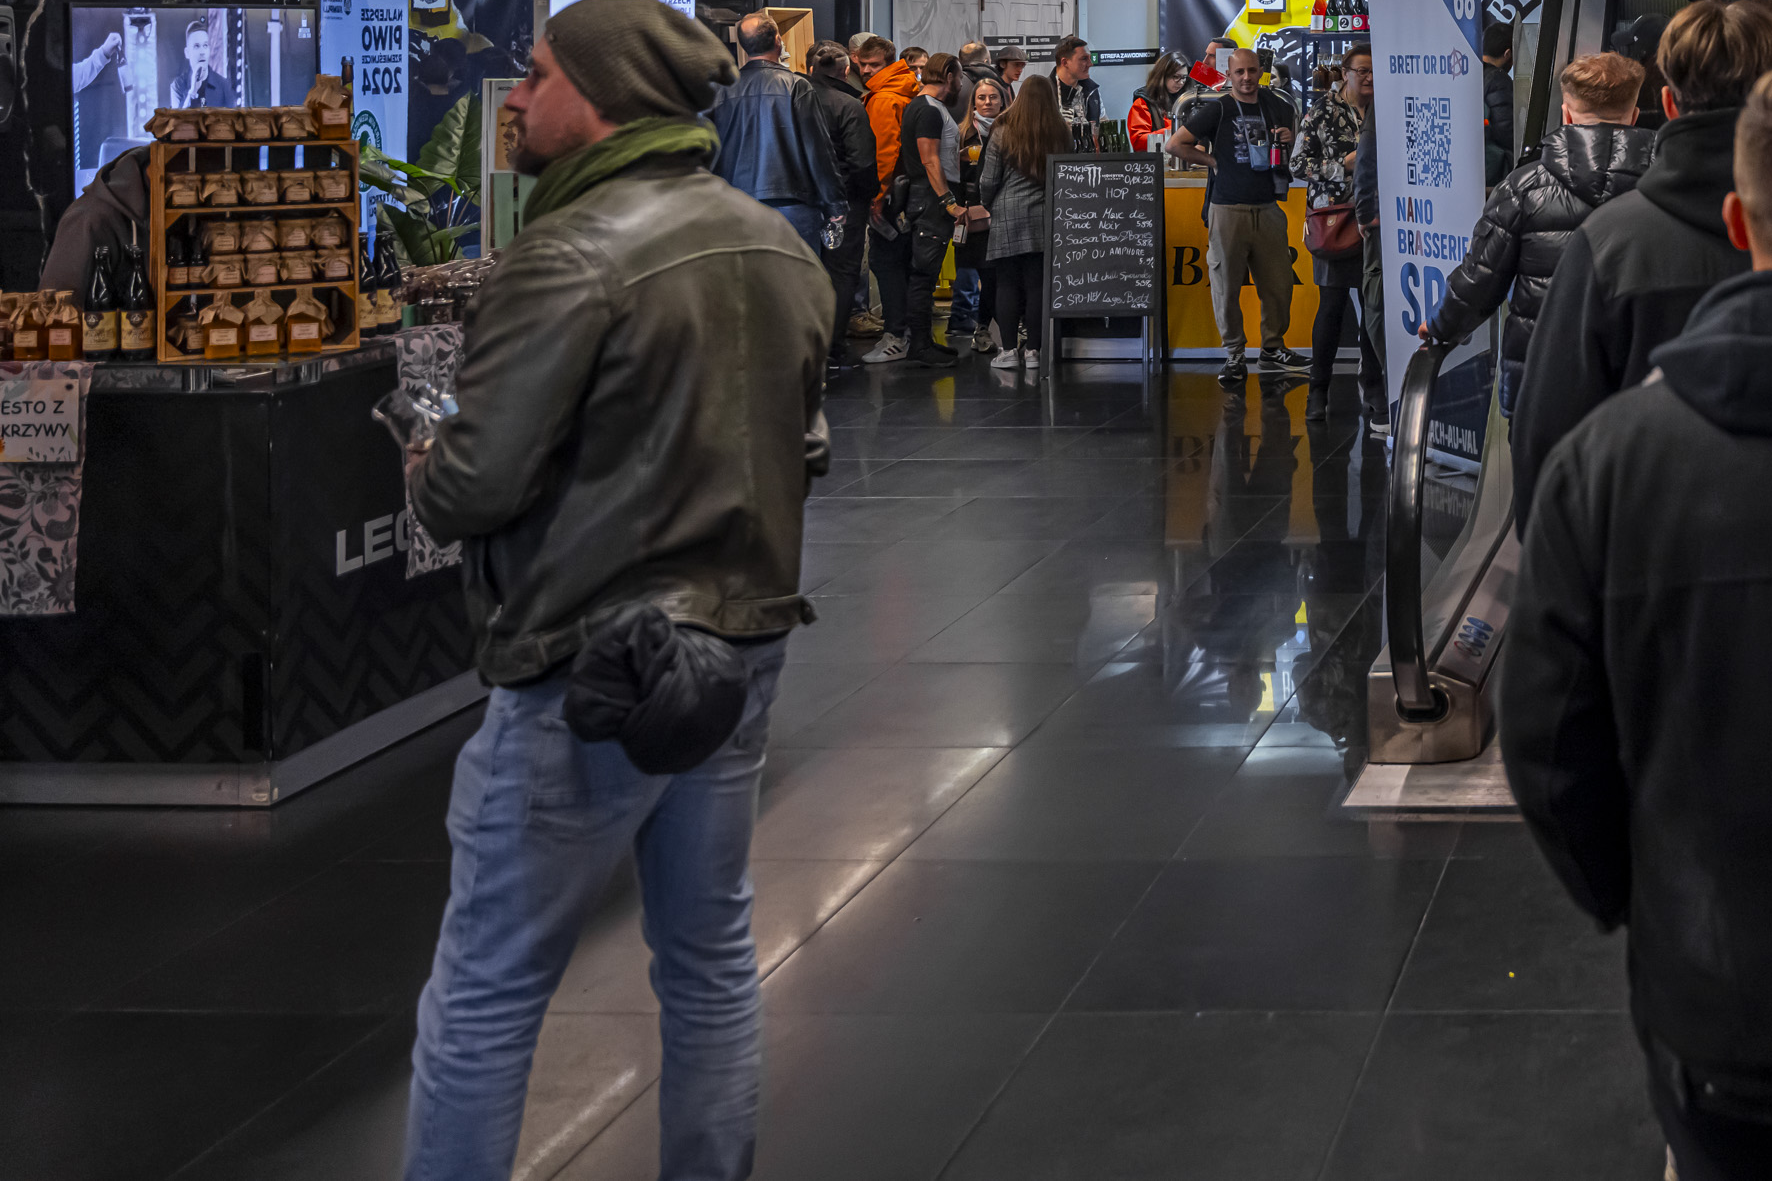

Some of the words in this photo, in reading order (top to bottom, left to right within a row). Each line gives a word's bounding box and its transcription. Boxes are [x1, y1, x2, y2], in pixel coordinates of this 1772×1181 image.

[1389, 54, 1421, 75] BRETT
[1423, 54, 1437, 75] OR
[1065, 188, 1099, 199] Saison
[1106, 187, 1129, 200] HOP
[1065, 208, 1097, 221] Saison
[1129, 209, 1148, 220] de
[1396, 196, 1434, 225] NANO
[1065, 234, 1099, 246] Saison
[1065, 248, 1088, 264] STOP
[1065, 273, 1084, 286] Red
[1, 400, 46, 416] ESTO
[53, 400, 65, 415] Z
